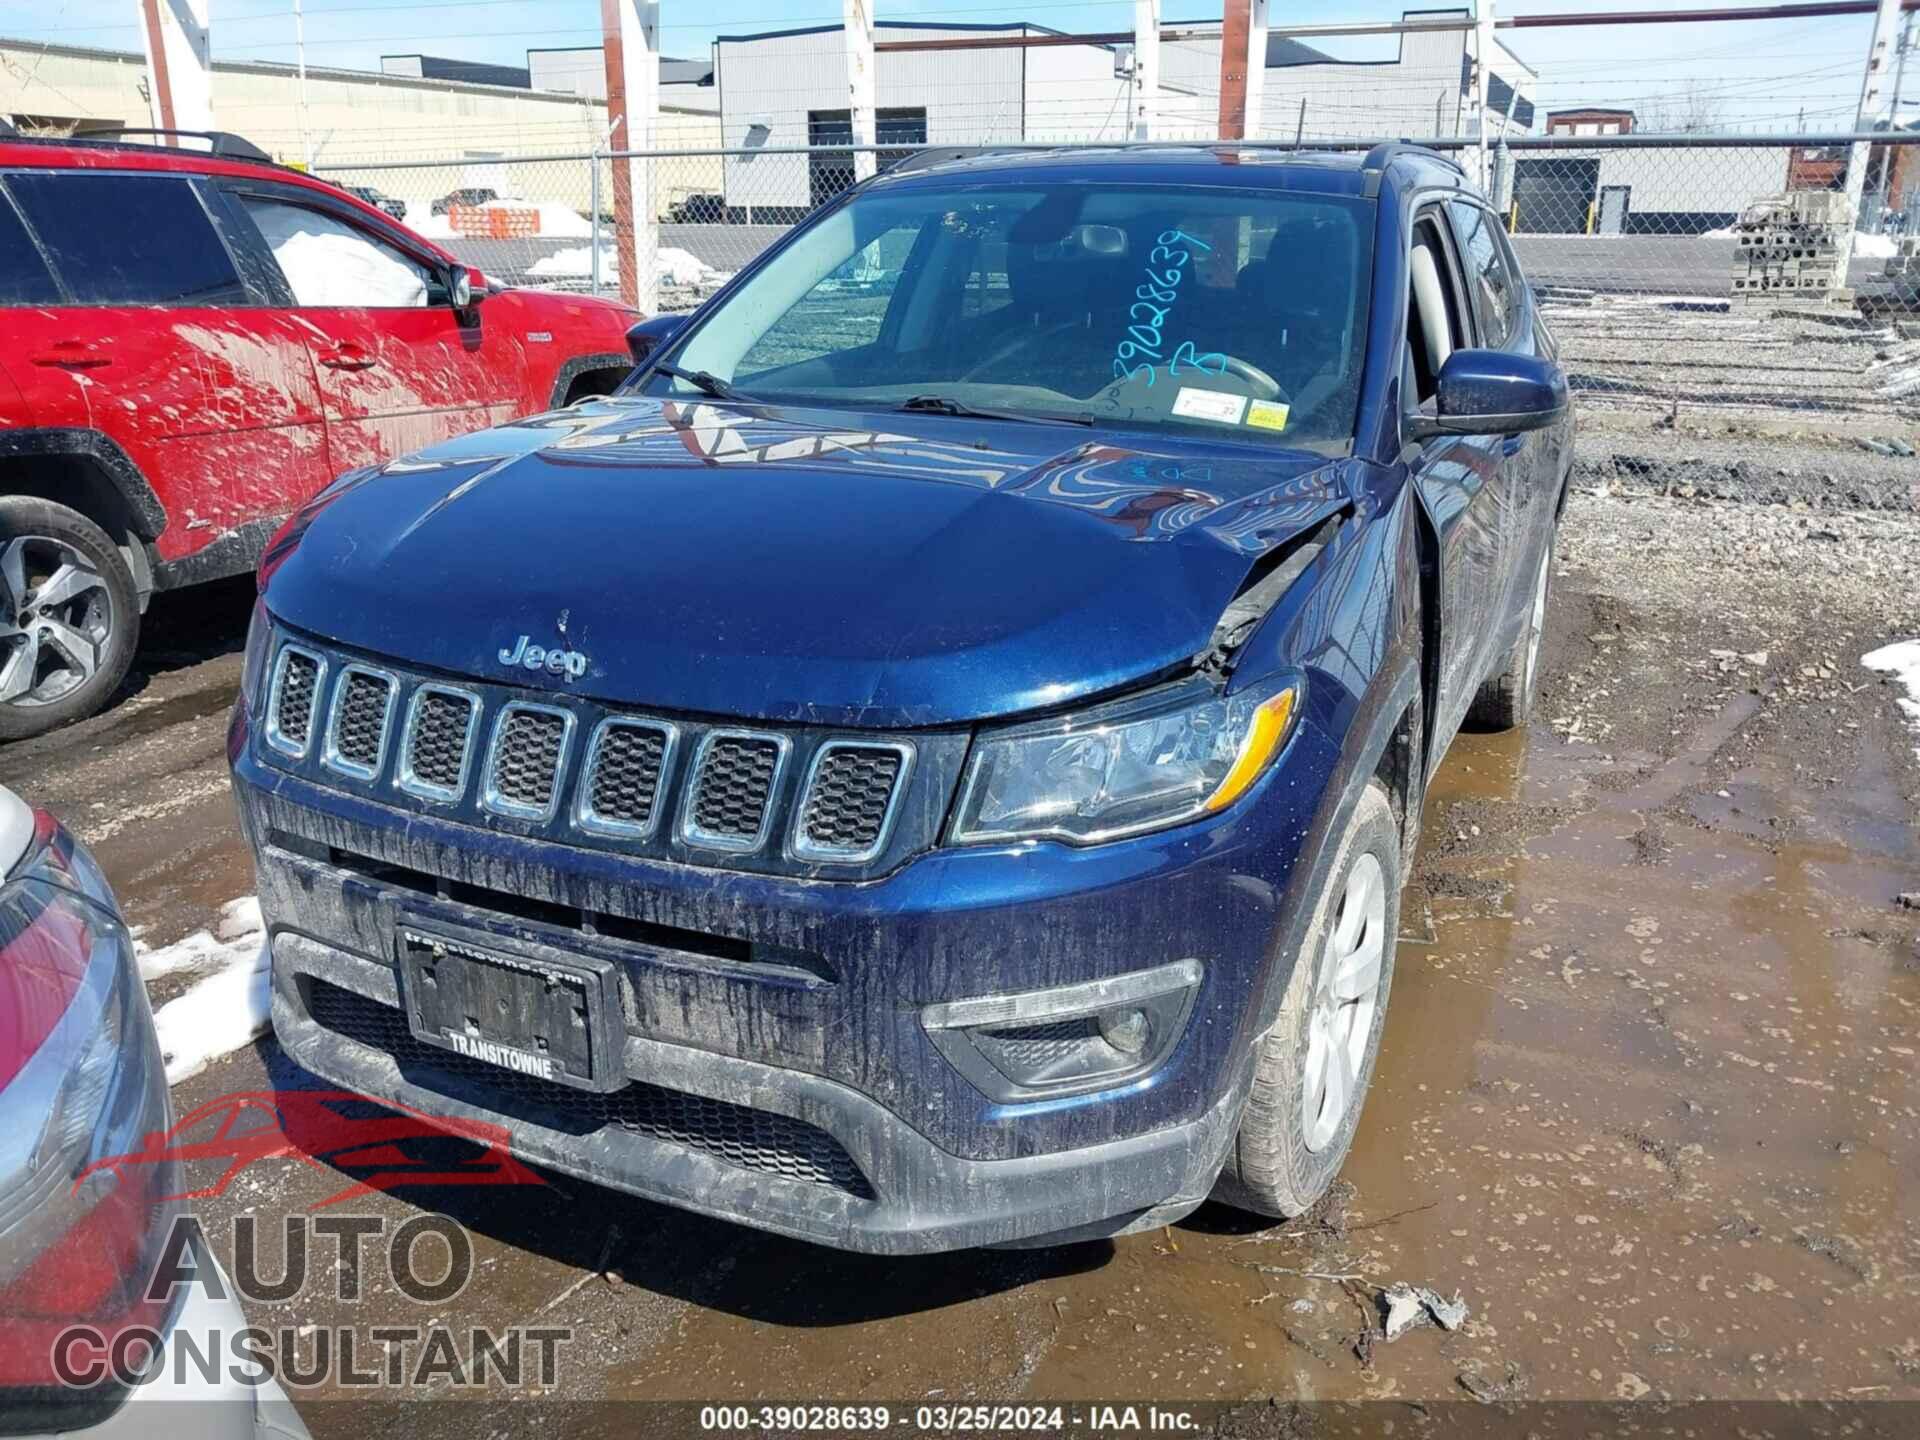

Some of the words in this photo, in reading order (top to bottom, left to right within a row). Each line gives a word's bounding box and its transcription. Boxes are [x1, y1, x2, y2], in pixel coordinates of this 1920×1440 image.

[1113, 230, 1212, 388] 39028639
[498, 635, 586, 683] Jeep
[449, 1032, 553, 1080] TRANSITOWNE
